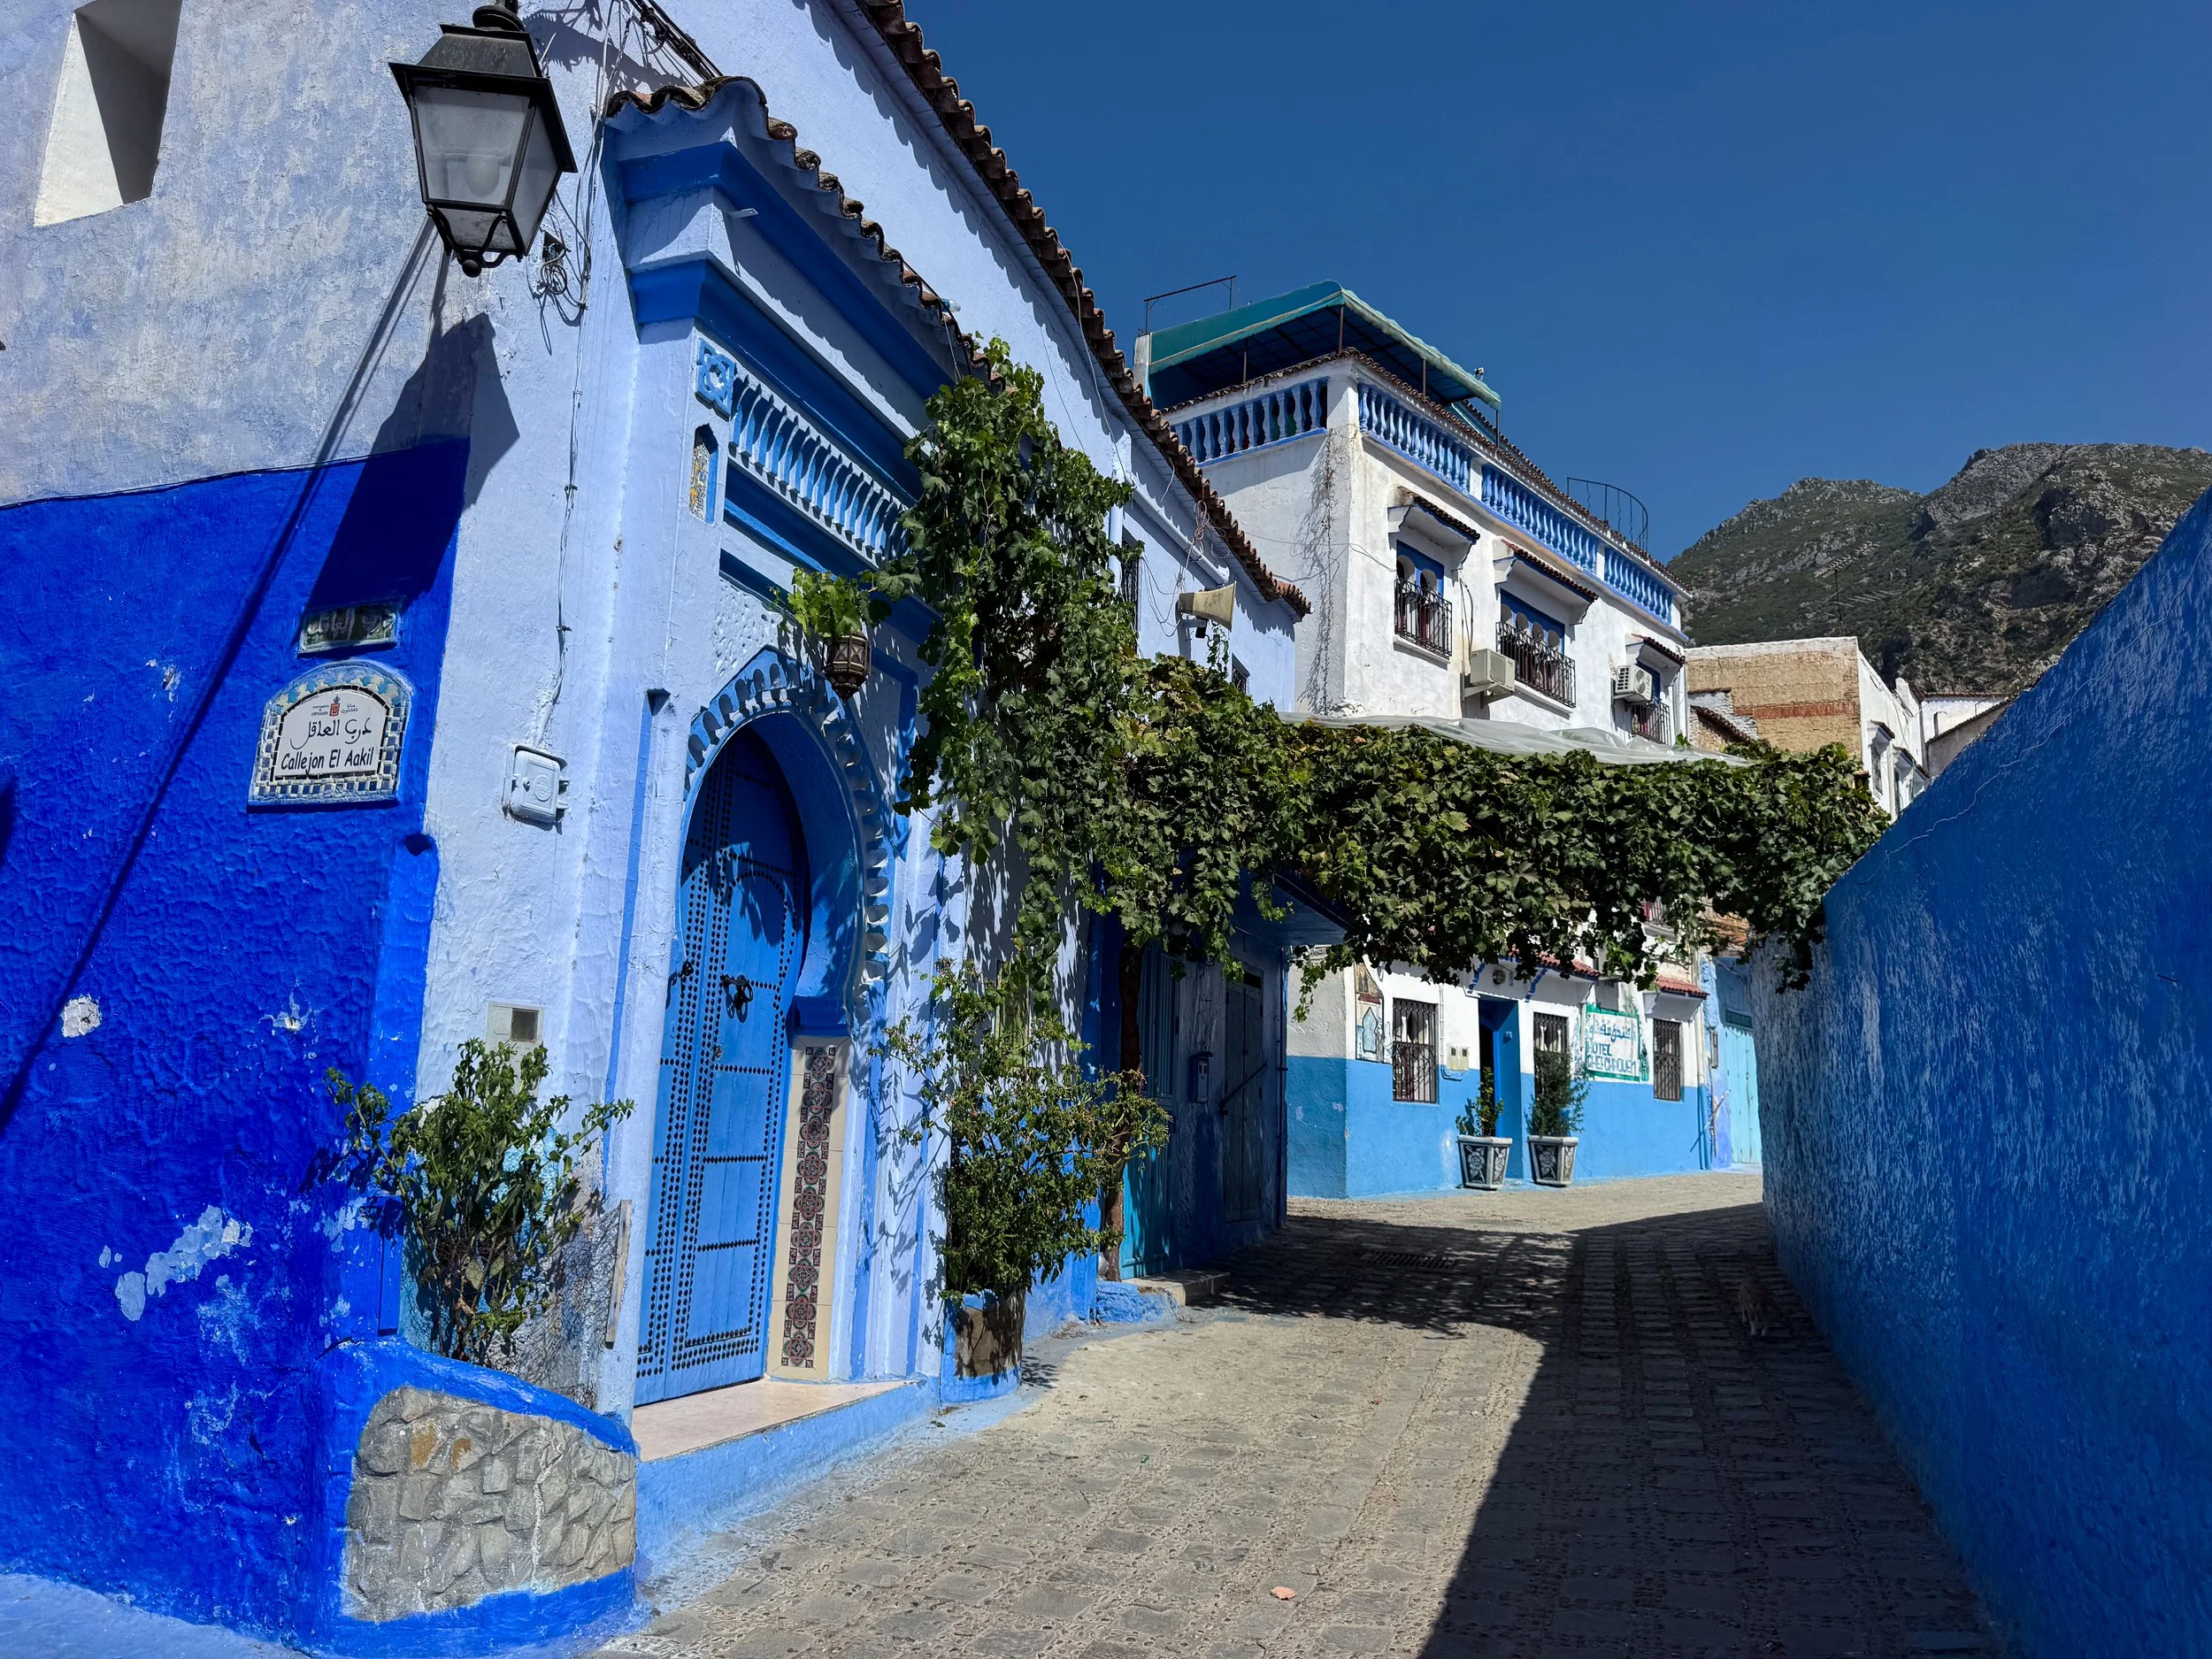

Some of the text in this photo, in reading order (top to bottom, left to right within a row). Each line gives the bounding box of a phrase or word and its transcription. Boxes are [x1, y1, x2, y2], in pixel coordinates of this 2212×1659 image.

[290, 718, 372, 749] درب العاقل
[280, 747, 374, 775] Callejon El Aakil
